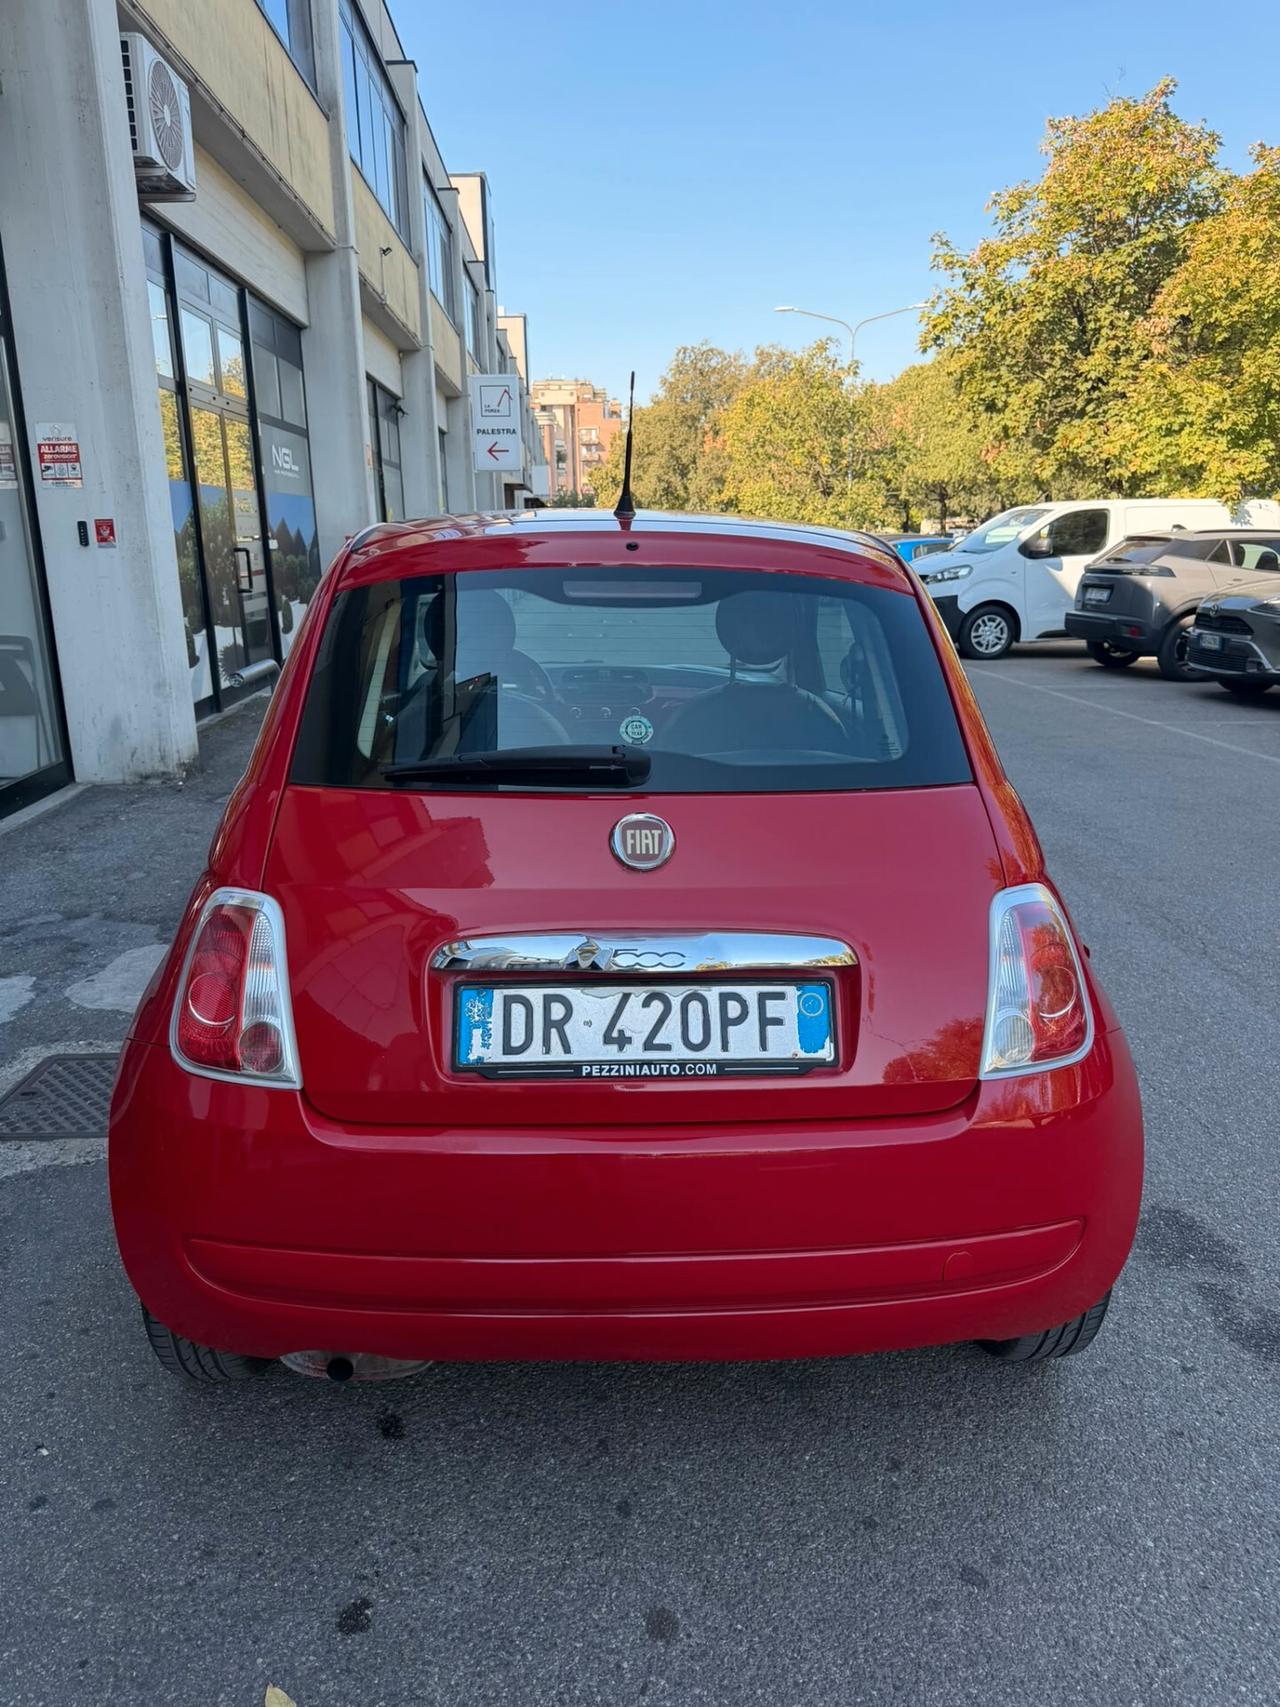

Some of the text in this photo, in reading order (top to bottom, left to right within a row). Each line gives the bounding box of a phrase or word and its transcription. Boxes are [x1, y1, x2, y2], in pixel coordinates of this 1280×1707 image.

[40, 445, 77, 453] ALLARME
[271, 444, 299, 472] NGL
[626, 829, 661, 855] FIAT
[613, 948, 686, 969] 500
[502, 991, 787, 1055] DR 420PF
[582, 1064, 717, 1077] PEZZINIAUTO.COM
